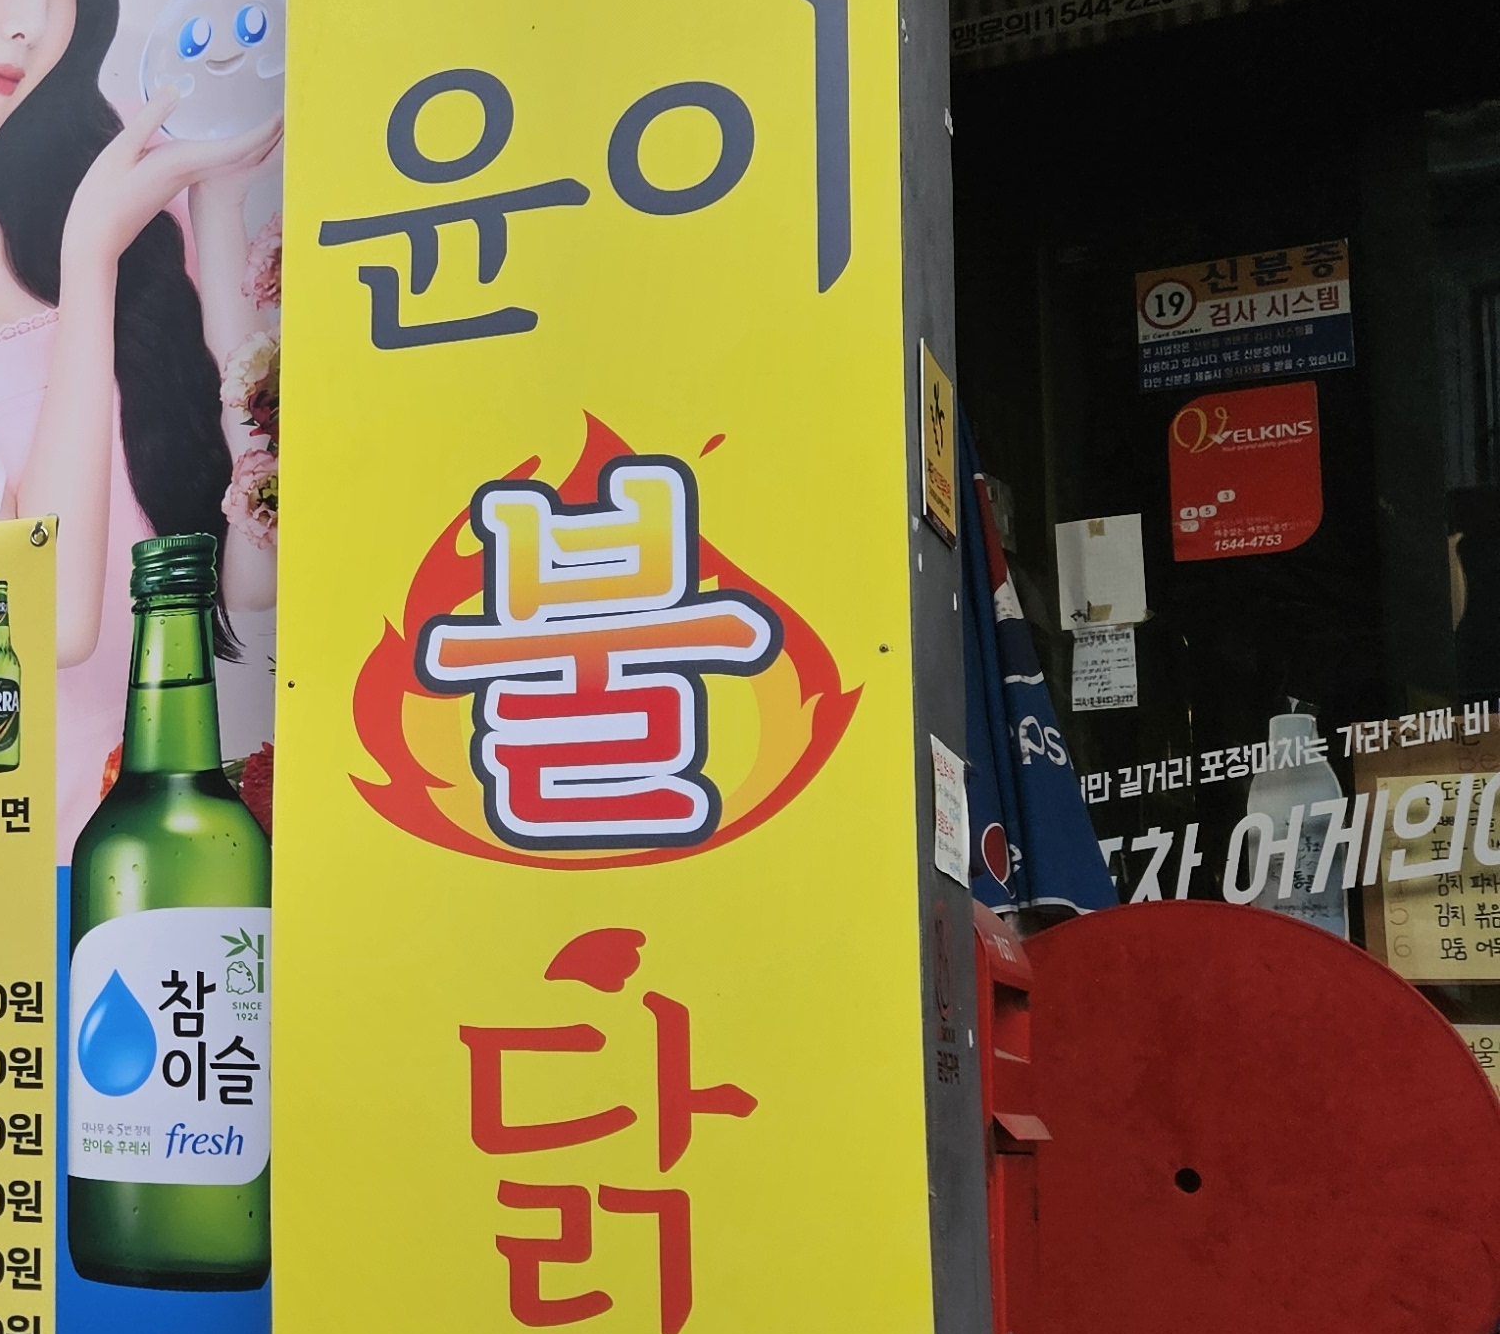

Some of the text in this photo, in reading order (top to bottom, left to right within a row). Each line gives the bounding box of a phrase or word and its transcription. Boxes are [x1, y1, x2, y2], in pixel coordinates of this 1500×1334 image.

[1199, 241, 1344, 295] 신분증
[1155, 292, 1185, 317] 19
[1209, 285, 1340, 327] 검사 시스템
[1214, 534, 1282, 552] 1544-4753
[1200, 737, 1329, 784] 포장마차는
[1336, 719, 1393, 757] 가라
[1399, 707, 1456, 748] 진짜
[232, 1002, 262, 1011] SINCE
[236, 1013, 259, 1021] 1924
[82, 1122, 105, 1134] 대나무
[82, 1138, 151, 1157] 참이슬 후레쉬
[165, 1122, 244, 1159] fresh
